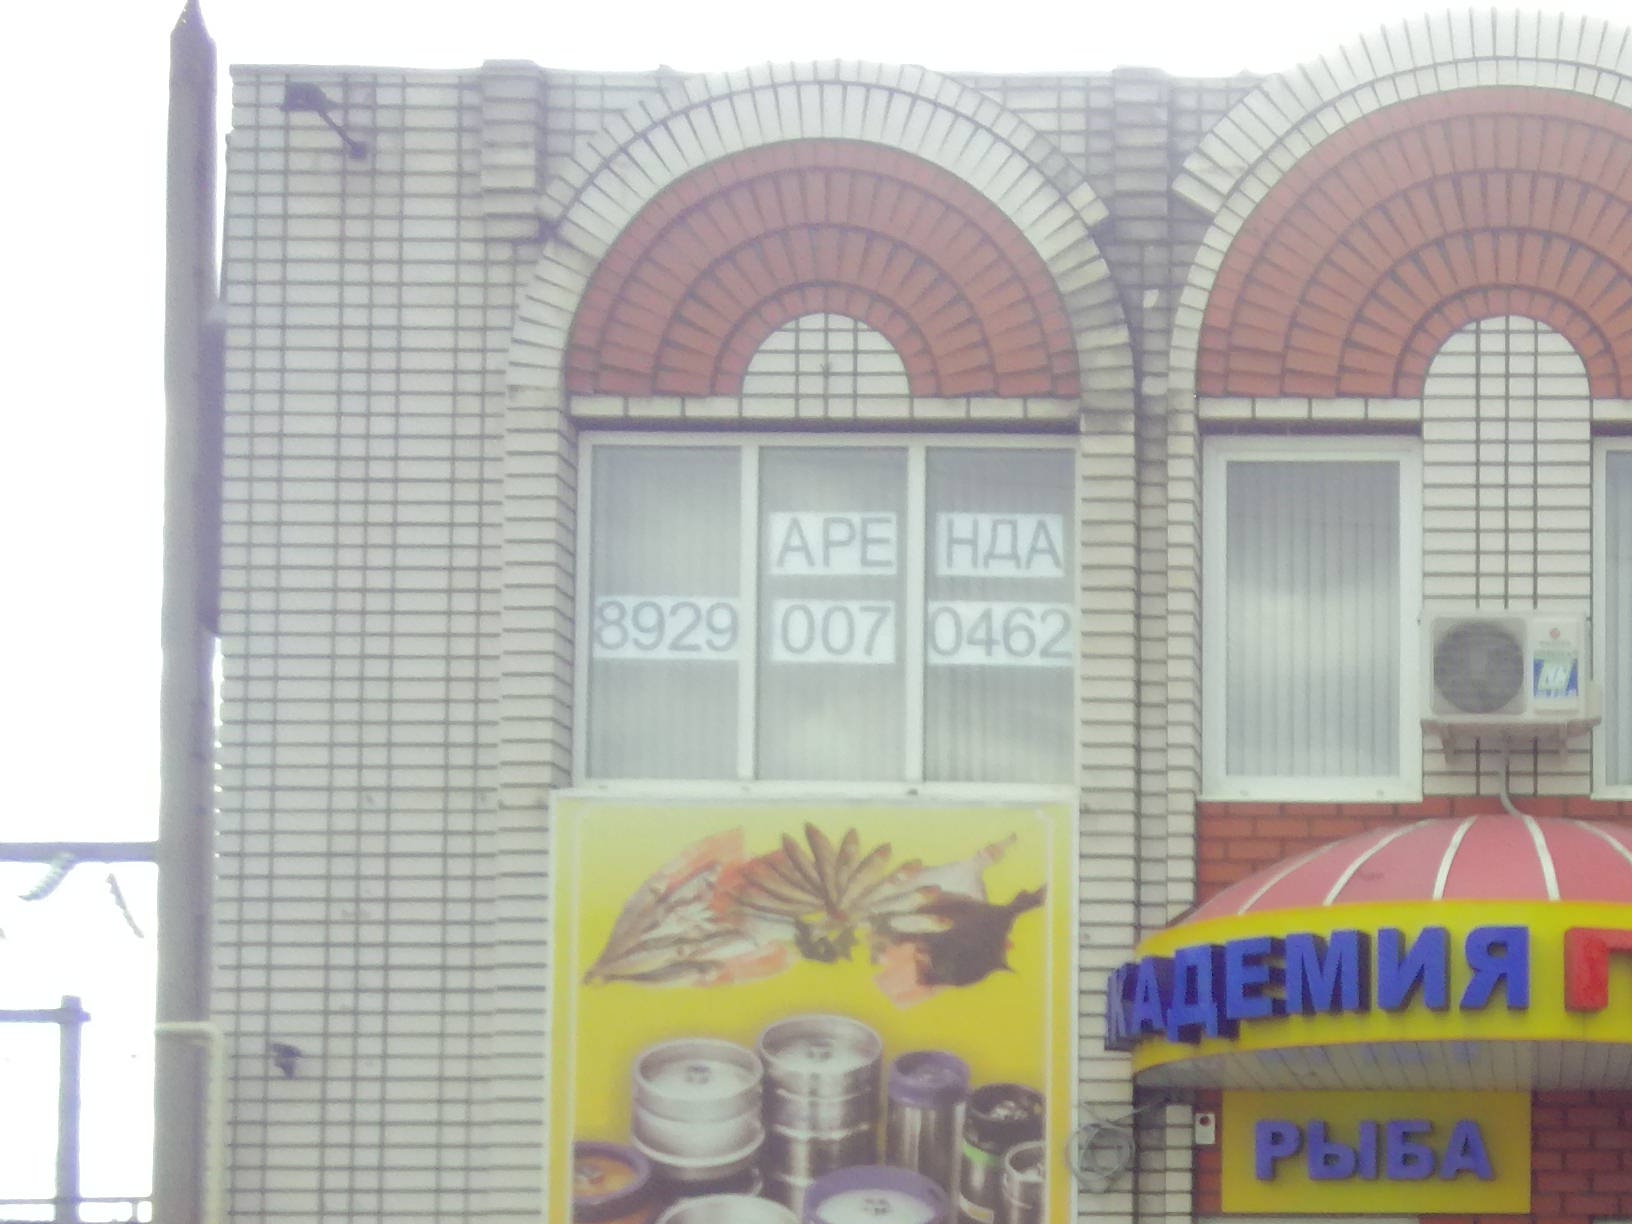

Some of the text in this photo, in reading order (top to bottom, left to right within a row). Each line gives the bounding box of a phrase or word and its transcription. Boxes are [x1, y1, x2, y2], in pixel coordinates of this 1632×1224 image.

[776, 516, 1063, 570] АРЕ НДА
[595, 600, 1073, 659] 8929 007 0462
[1253, 1119, 1496, 1183] РЫБА
